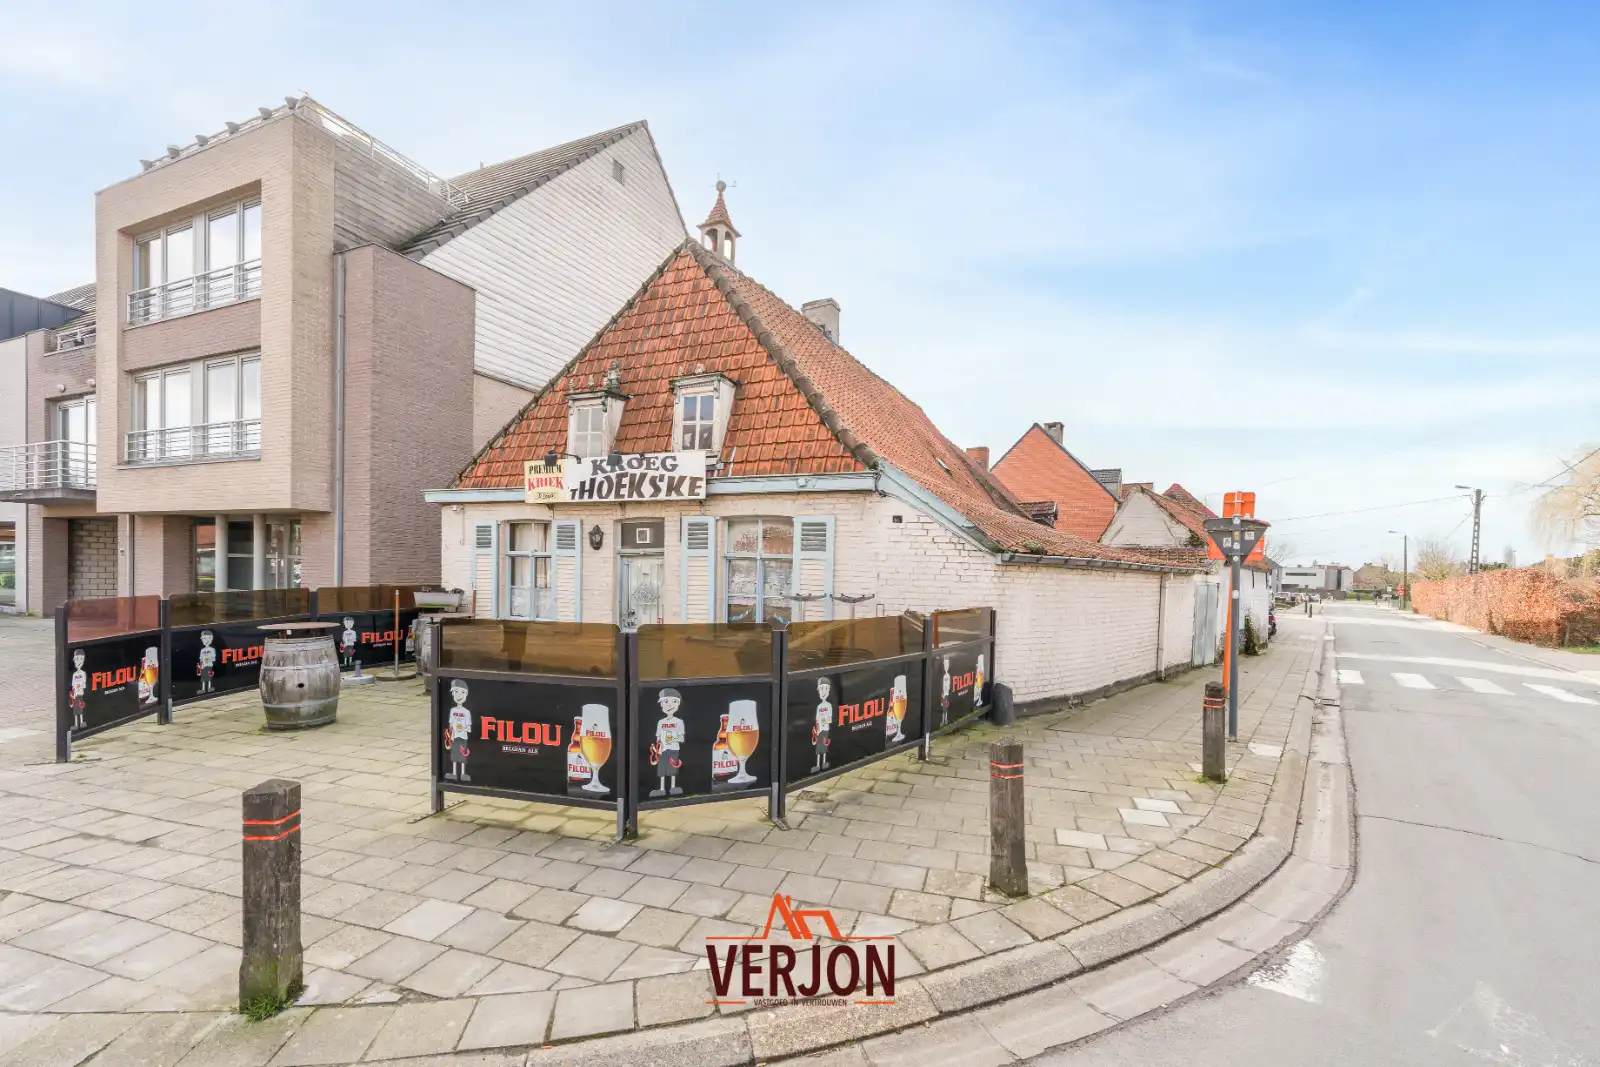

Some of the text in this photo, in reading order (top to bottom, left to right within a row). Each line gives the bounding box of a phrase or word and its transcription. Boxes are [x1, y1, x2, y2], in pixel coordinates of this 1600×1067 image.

[528, 464, 562, 475] PREMIUM
[527, 476, 564, 492] KRIEK
[91, 665, 137, 691] FILOU
[952, 671, 974, 692] FILOU
[838, 697, 885, 727] FILOU
[480, 715, 562, 746] FILOU
